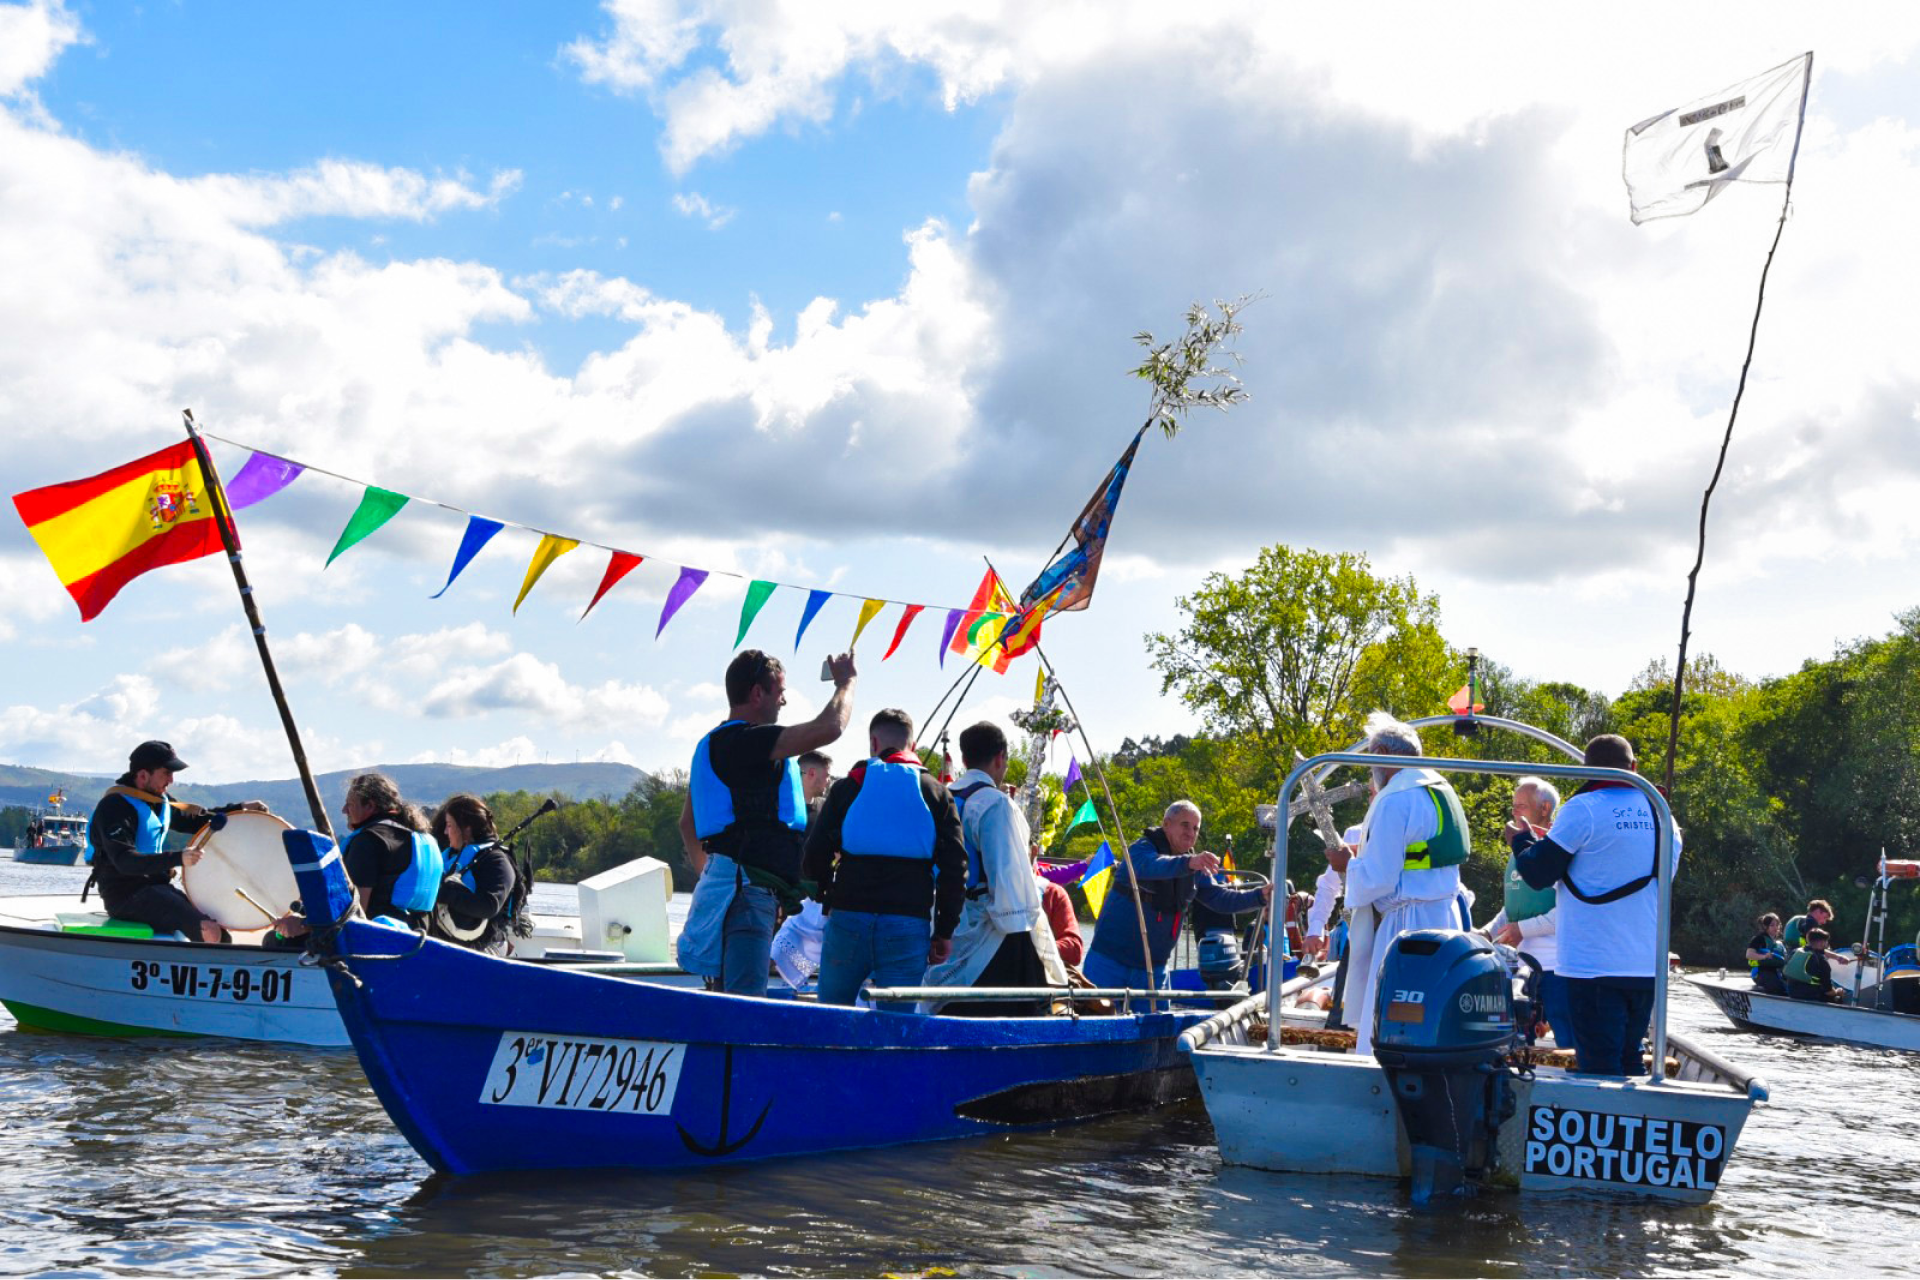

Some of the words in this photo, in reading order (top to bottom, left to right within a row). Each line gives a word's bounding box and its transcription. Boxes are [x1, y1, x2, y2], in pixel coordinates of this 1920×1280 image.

[1392, 989, 1425, 1004] 30
[1532, 1107, 1723, 1160] SOUTELO
[1525, 1140, 1717, 1191] PORTUGAL
